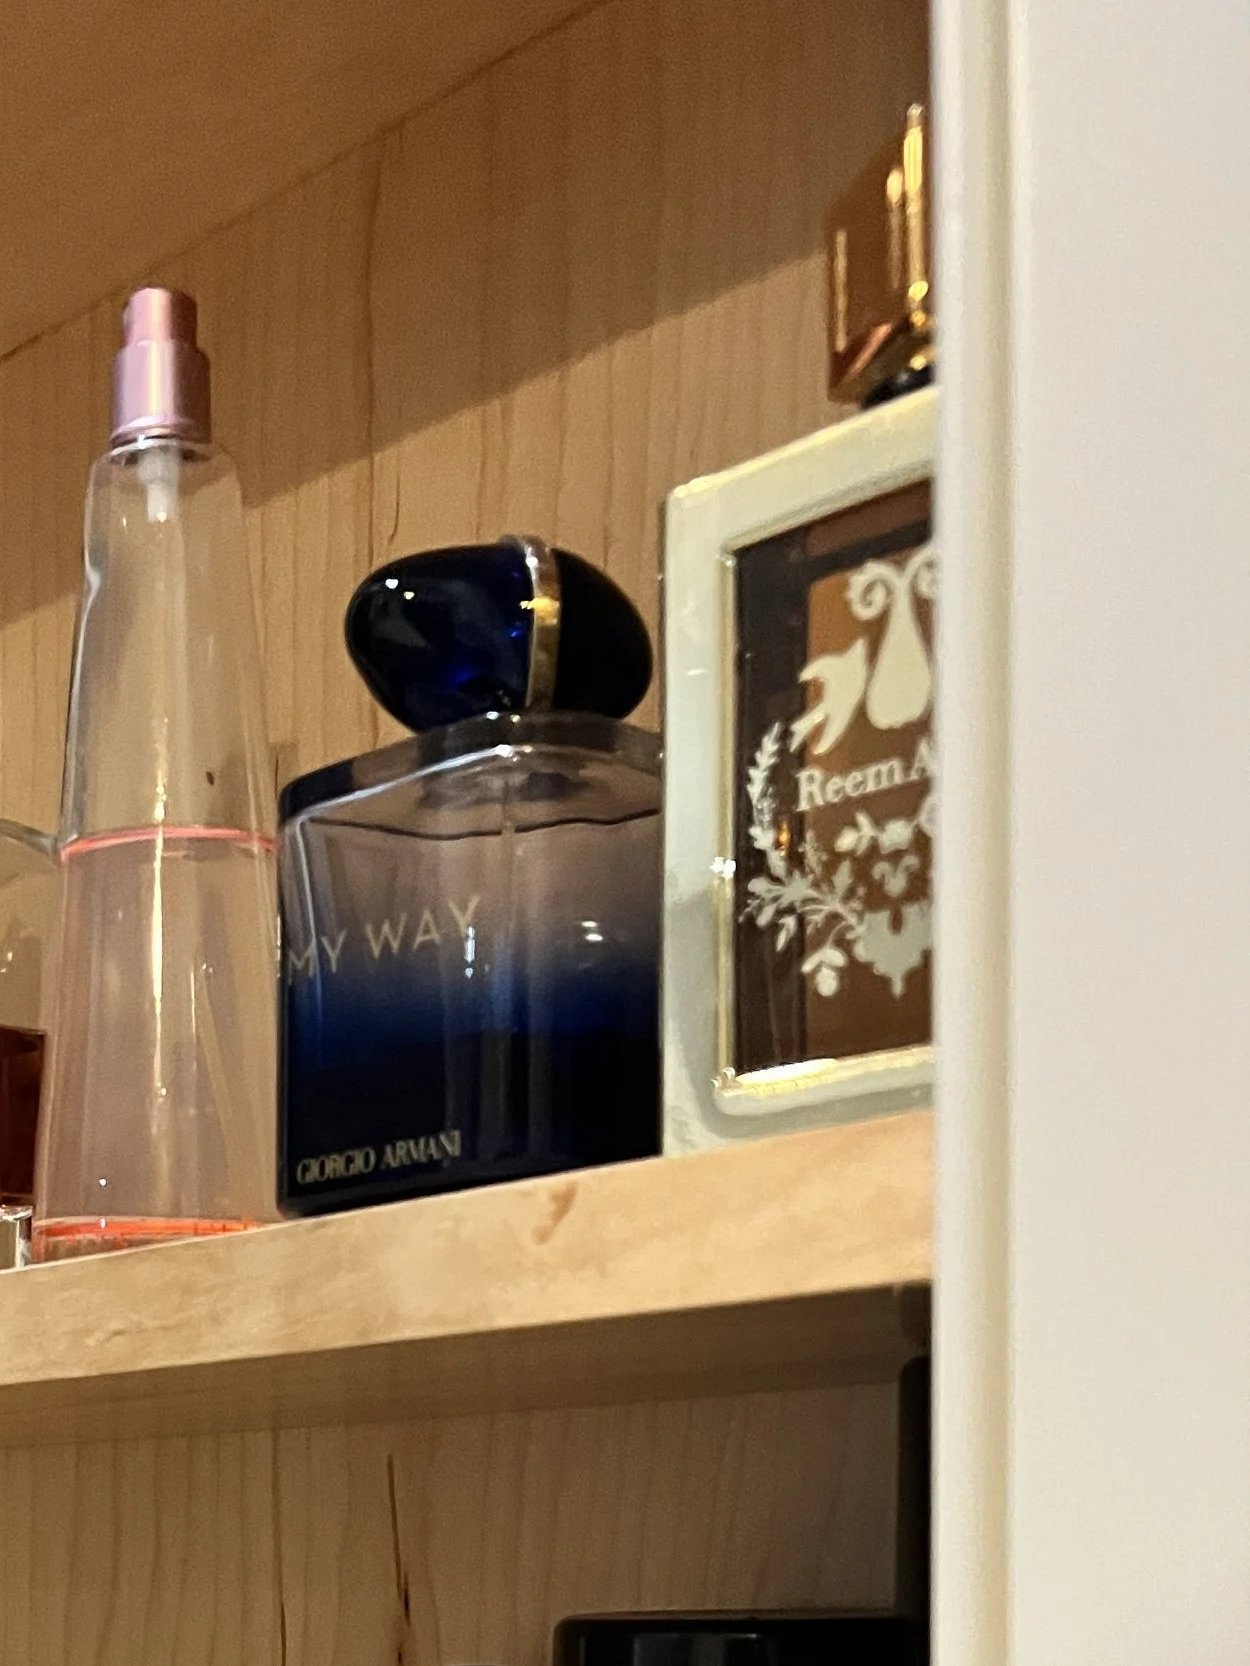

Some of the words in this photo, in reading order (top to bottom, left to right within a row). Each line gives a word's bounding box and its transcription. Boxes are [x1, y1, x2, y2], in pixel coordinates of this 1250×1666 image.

[795, 758, 903, 812] Reem
[286, 930, 347, 985] MY
[365, 896, 480, 961] WAY
[296, 1147, 376, 1184] GIORGIO
[380, 1129, 462, 1170] ARMANI
